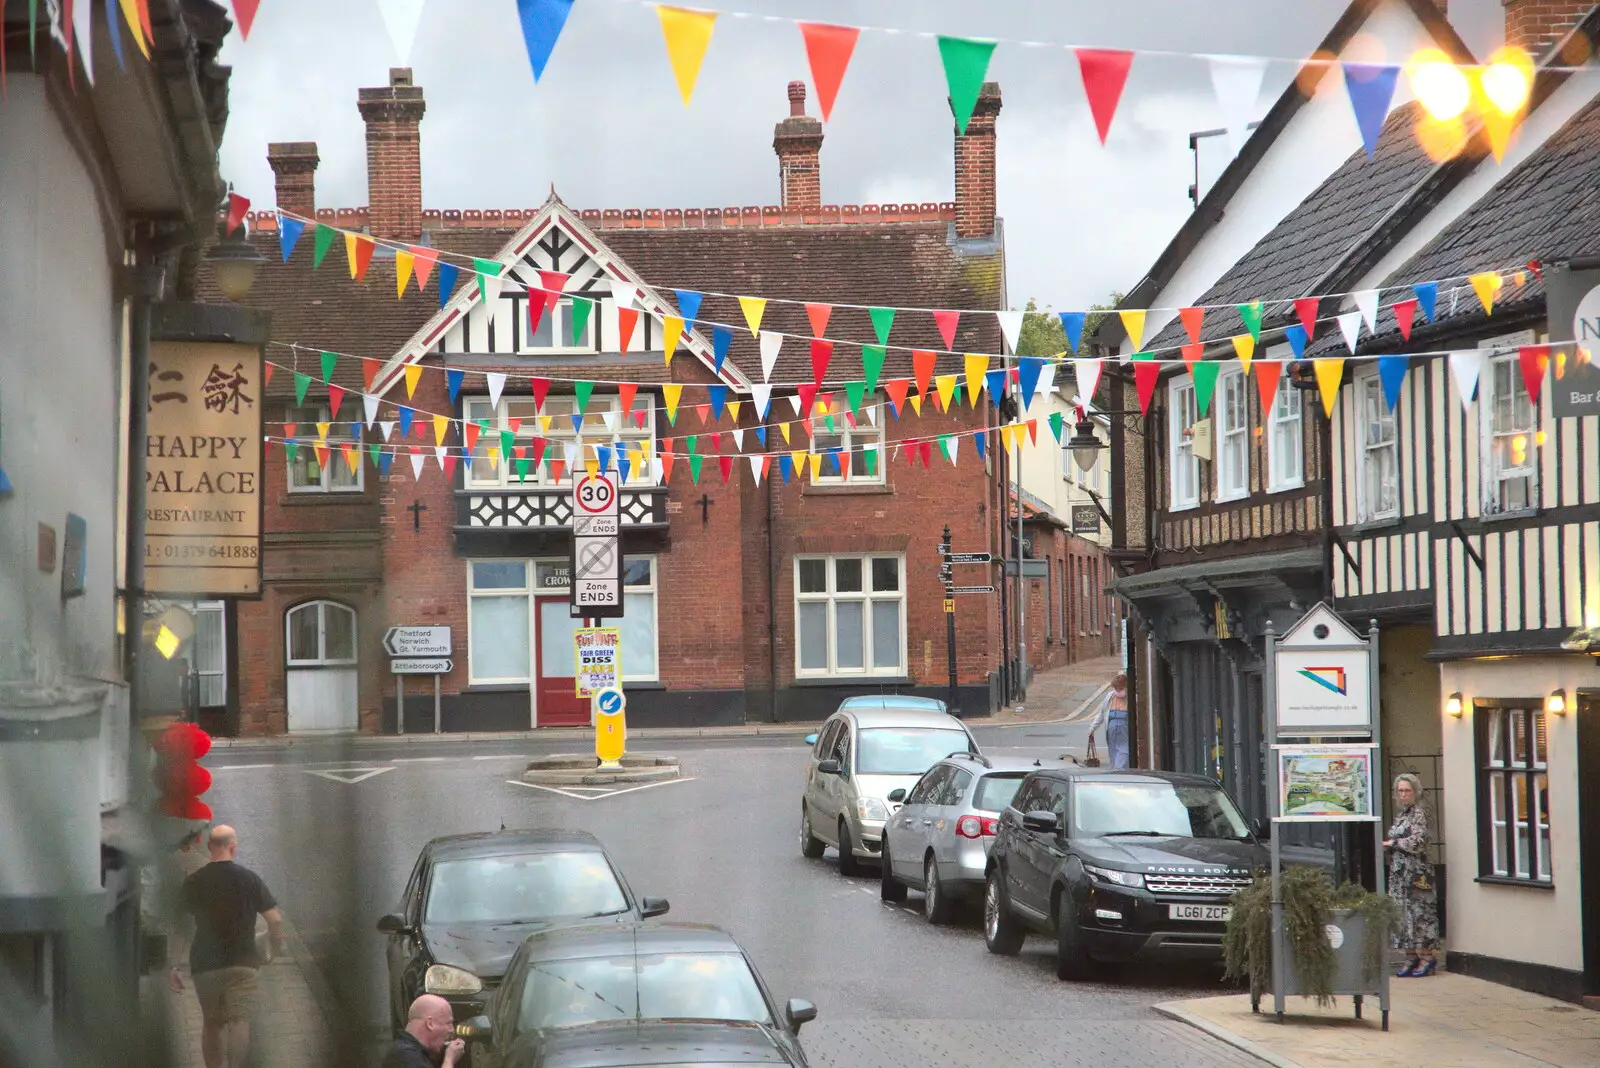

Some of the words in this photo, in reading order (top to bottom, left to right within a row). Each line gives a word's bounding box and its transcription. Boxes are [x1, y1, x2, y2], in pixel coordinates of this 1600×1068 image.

[1570, 391, 1594, 404] Bar
[146, 435, 247, 459] HAPPY
[582, 486, 609, 502] 30
[592, 525, 616, 533] ENDS
[208, 546, 258, 559] 641888
[554, 568, 570, 576] THE
[580, 592, 614, 601] ENDS
[595, 649, 614, 657] GREEN
[583, 656, 612, 664] DISS
[1176, 906, 1203, 918] LG61
